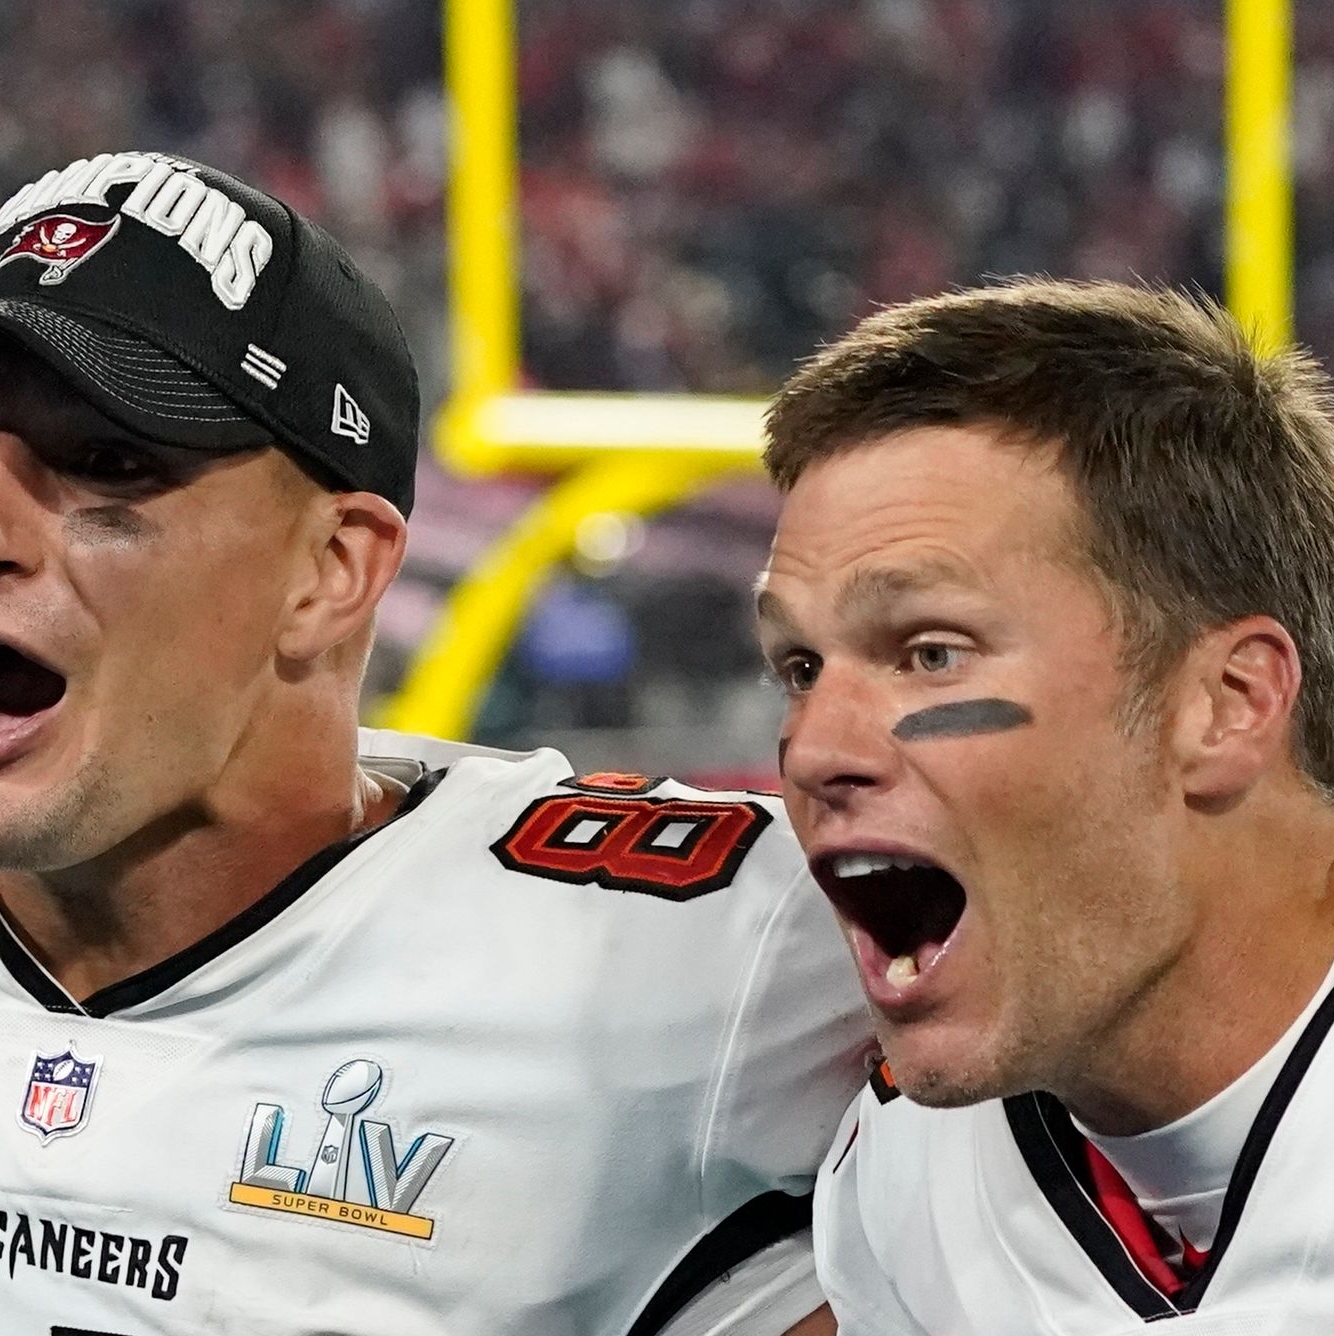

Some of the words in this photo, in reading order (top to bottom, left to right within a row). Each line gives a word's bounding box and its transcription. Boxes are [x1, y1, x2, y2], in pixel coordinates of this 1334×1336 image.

[27, 1084, 79, 1127] NFL
[271, 1194, 330, 1214] SUPER
[338, 1206, 388, 1226] BOWL
